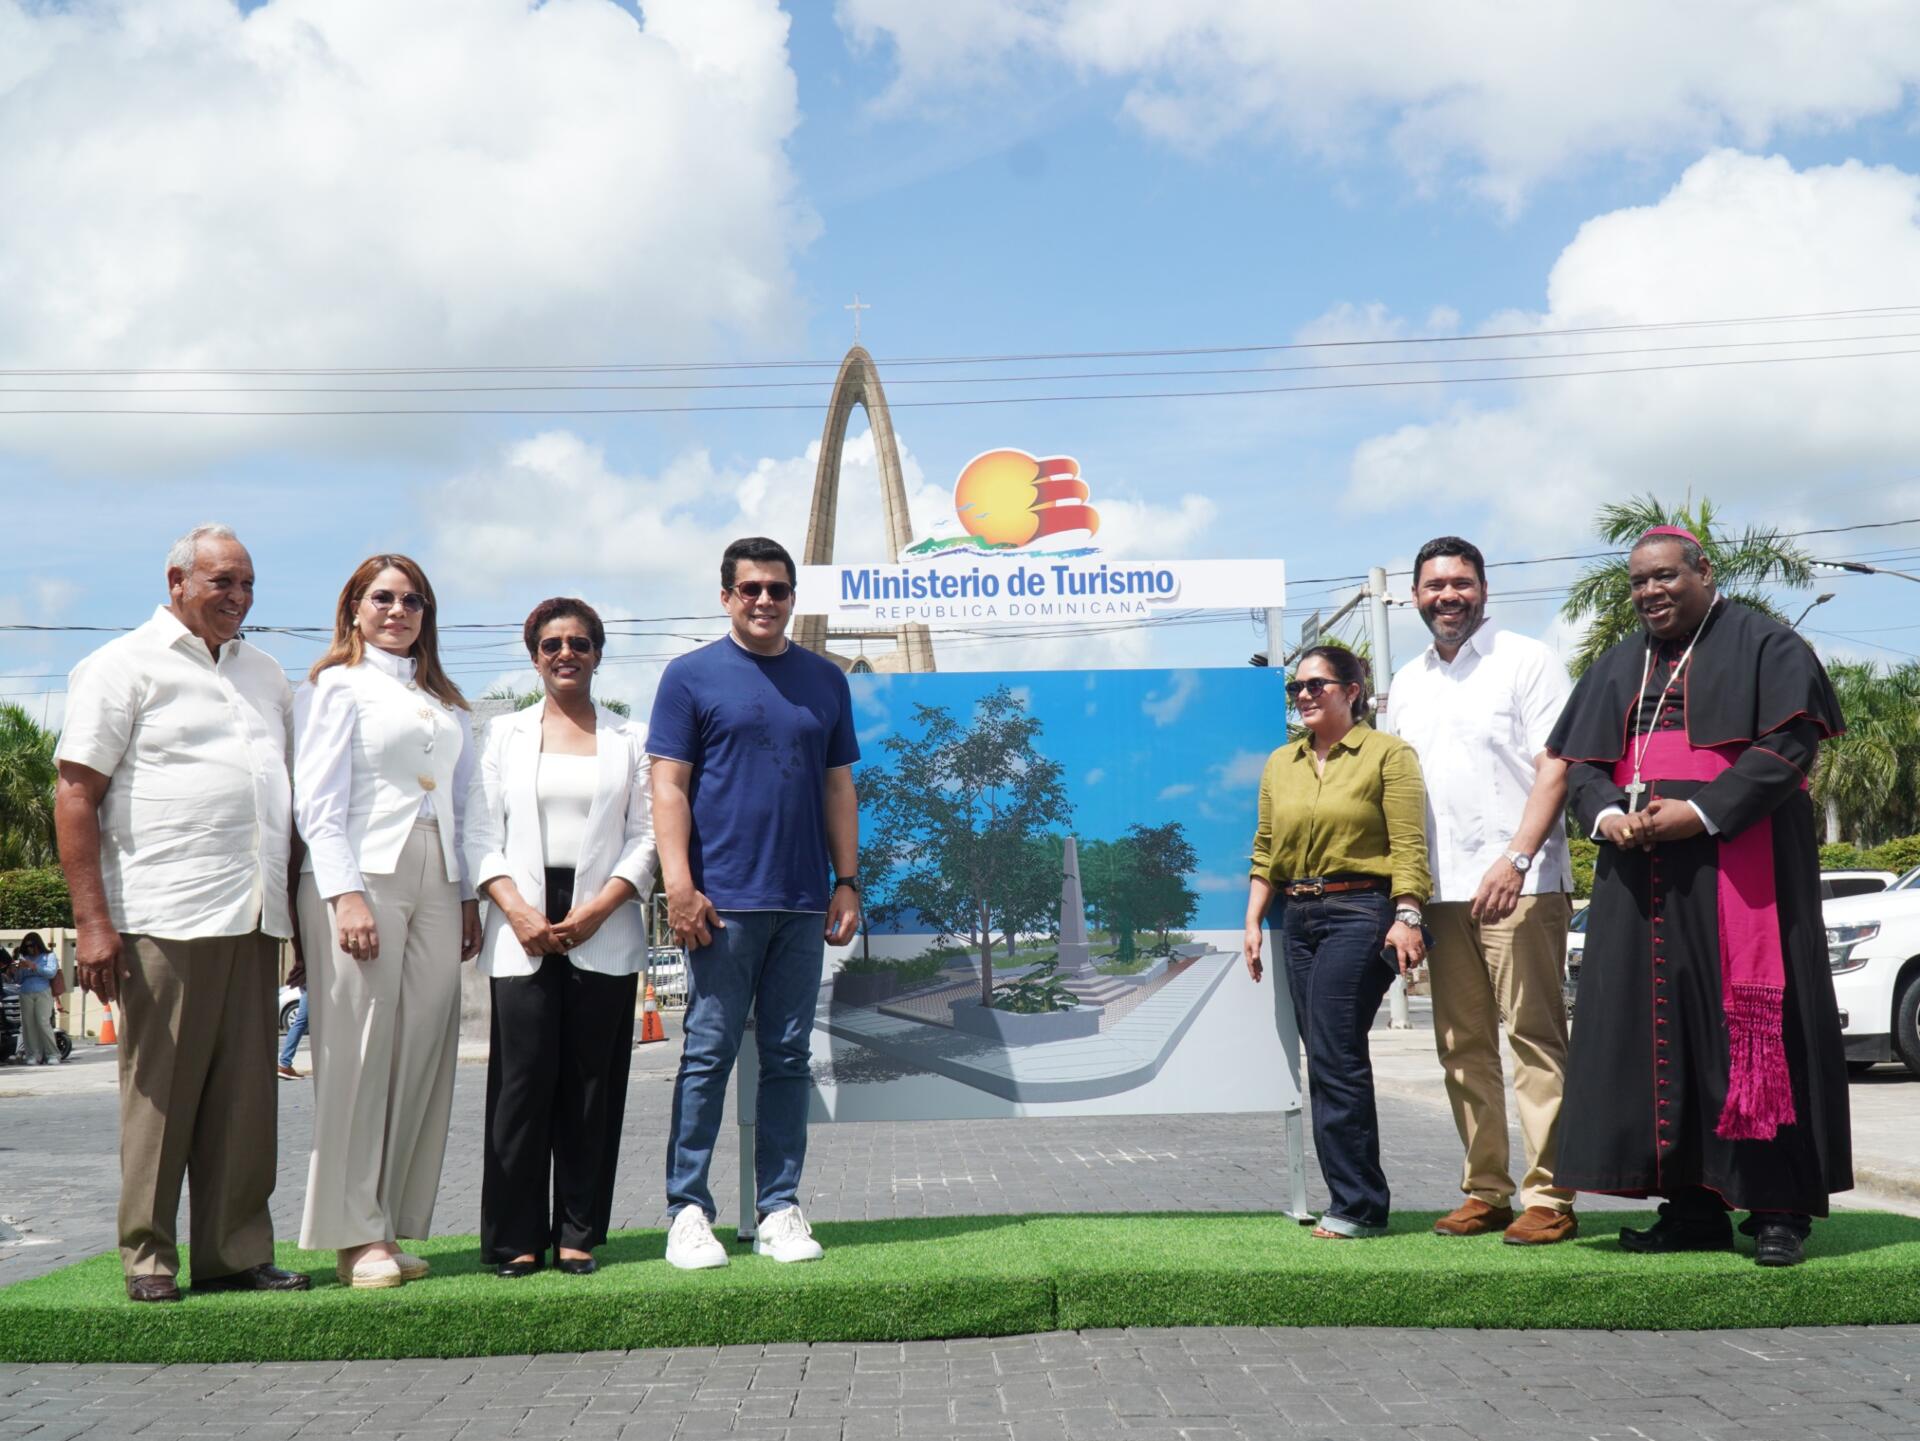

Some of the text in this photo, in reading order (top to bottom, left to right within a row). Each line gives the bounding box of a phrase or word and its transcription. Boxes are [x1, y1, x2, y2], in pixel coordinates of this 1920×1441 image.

[841, 564, 1174, 600] Ministerio de Turismo
[876, 601, 1146, 618] REPÚBLICA DOMINICANA
